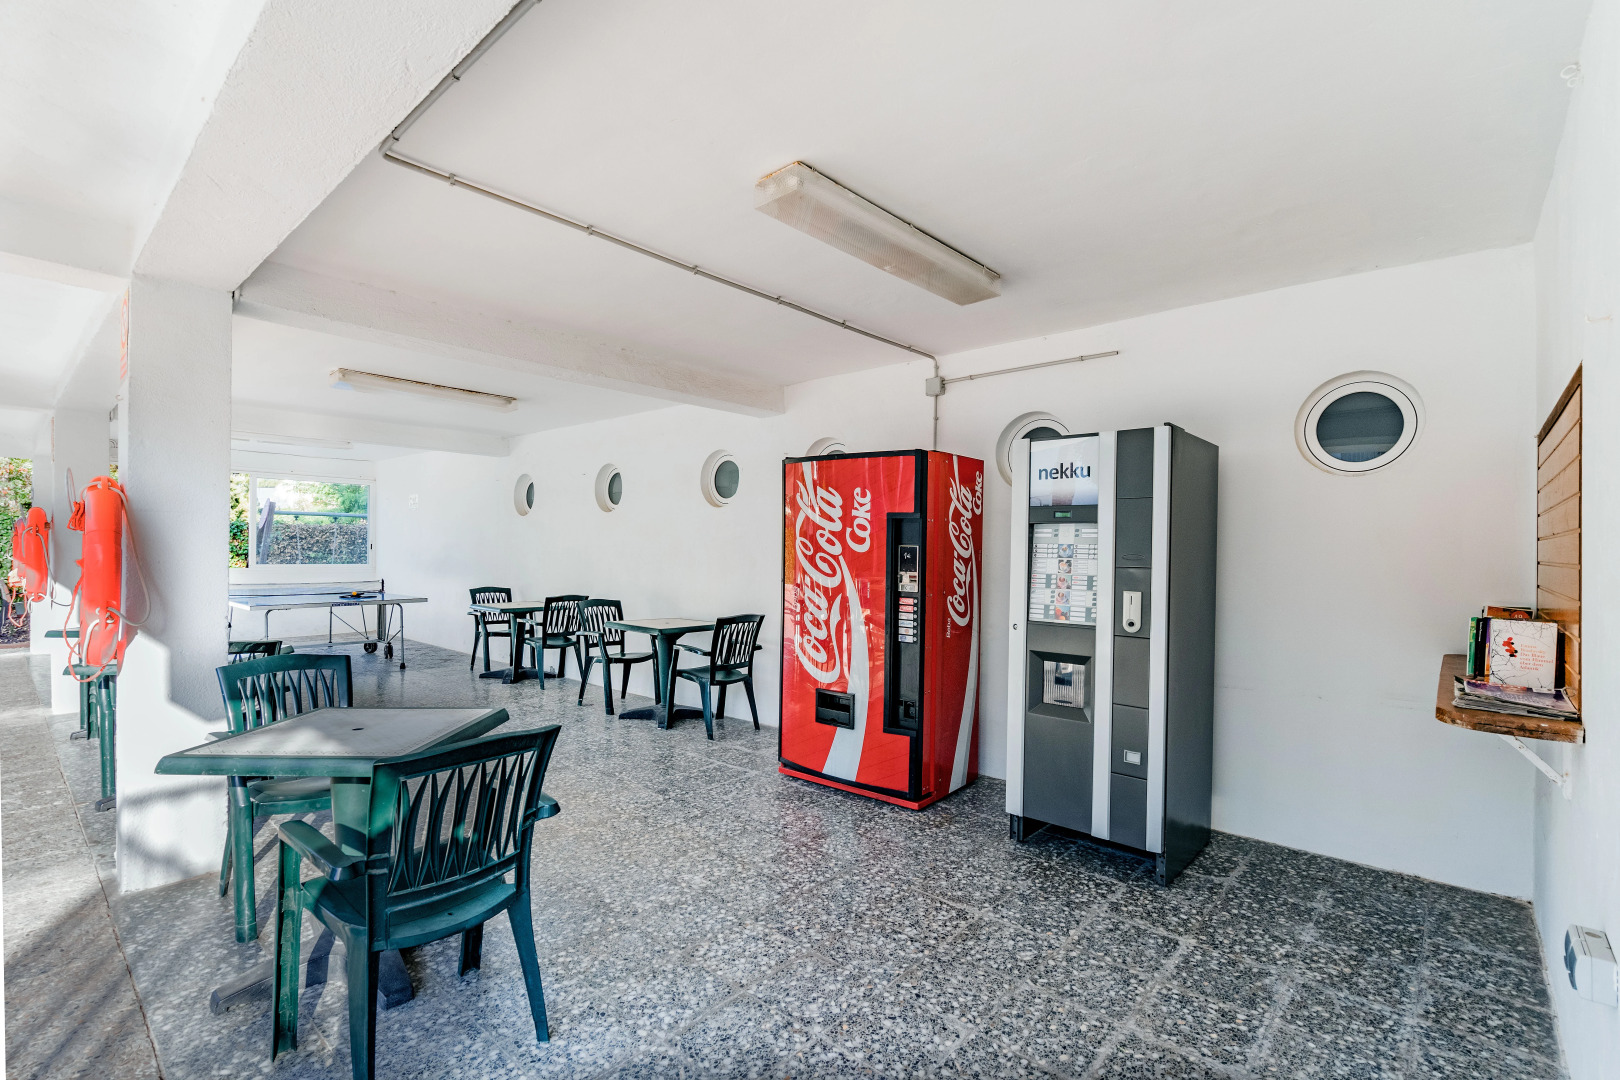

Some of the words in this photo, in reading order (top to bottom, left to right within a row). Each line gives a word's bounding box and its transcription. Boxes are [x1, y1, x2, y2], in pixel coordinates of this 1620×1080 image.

[972, 470, 983, 516] Coke
[1038, 461, 1091, 481] nekku
[846, 486, 872, 553] Coke
[946, 477, 973, 628] Coca-Cola
[794, 480, 843, 684] Coca-Cola
